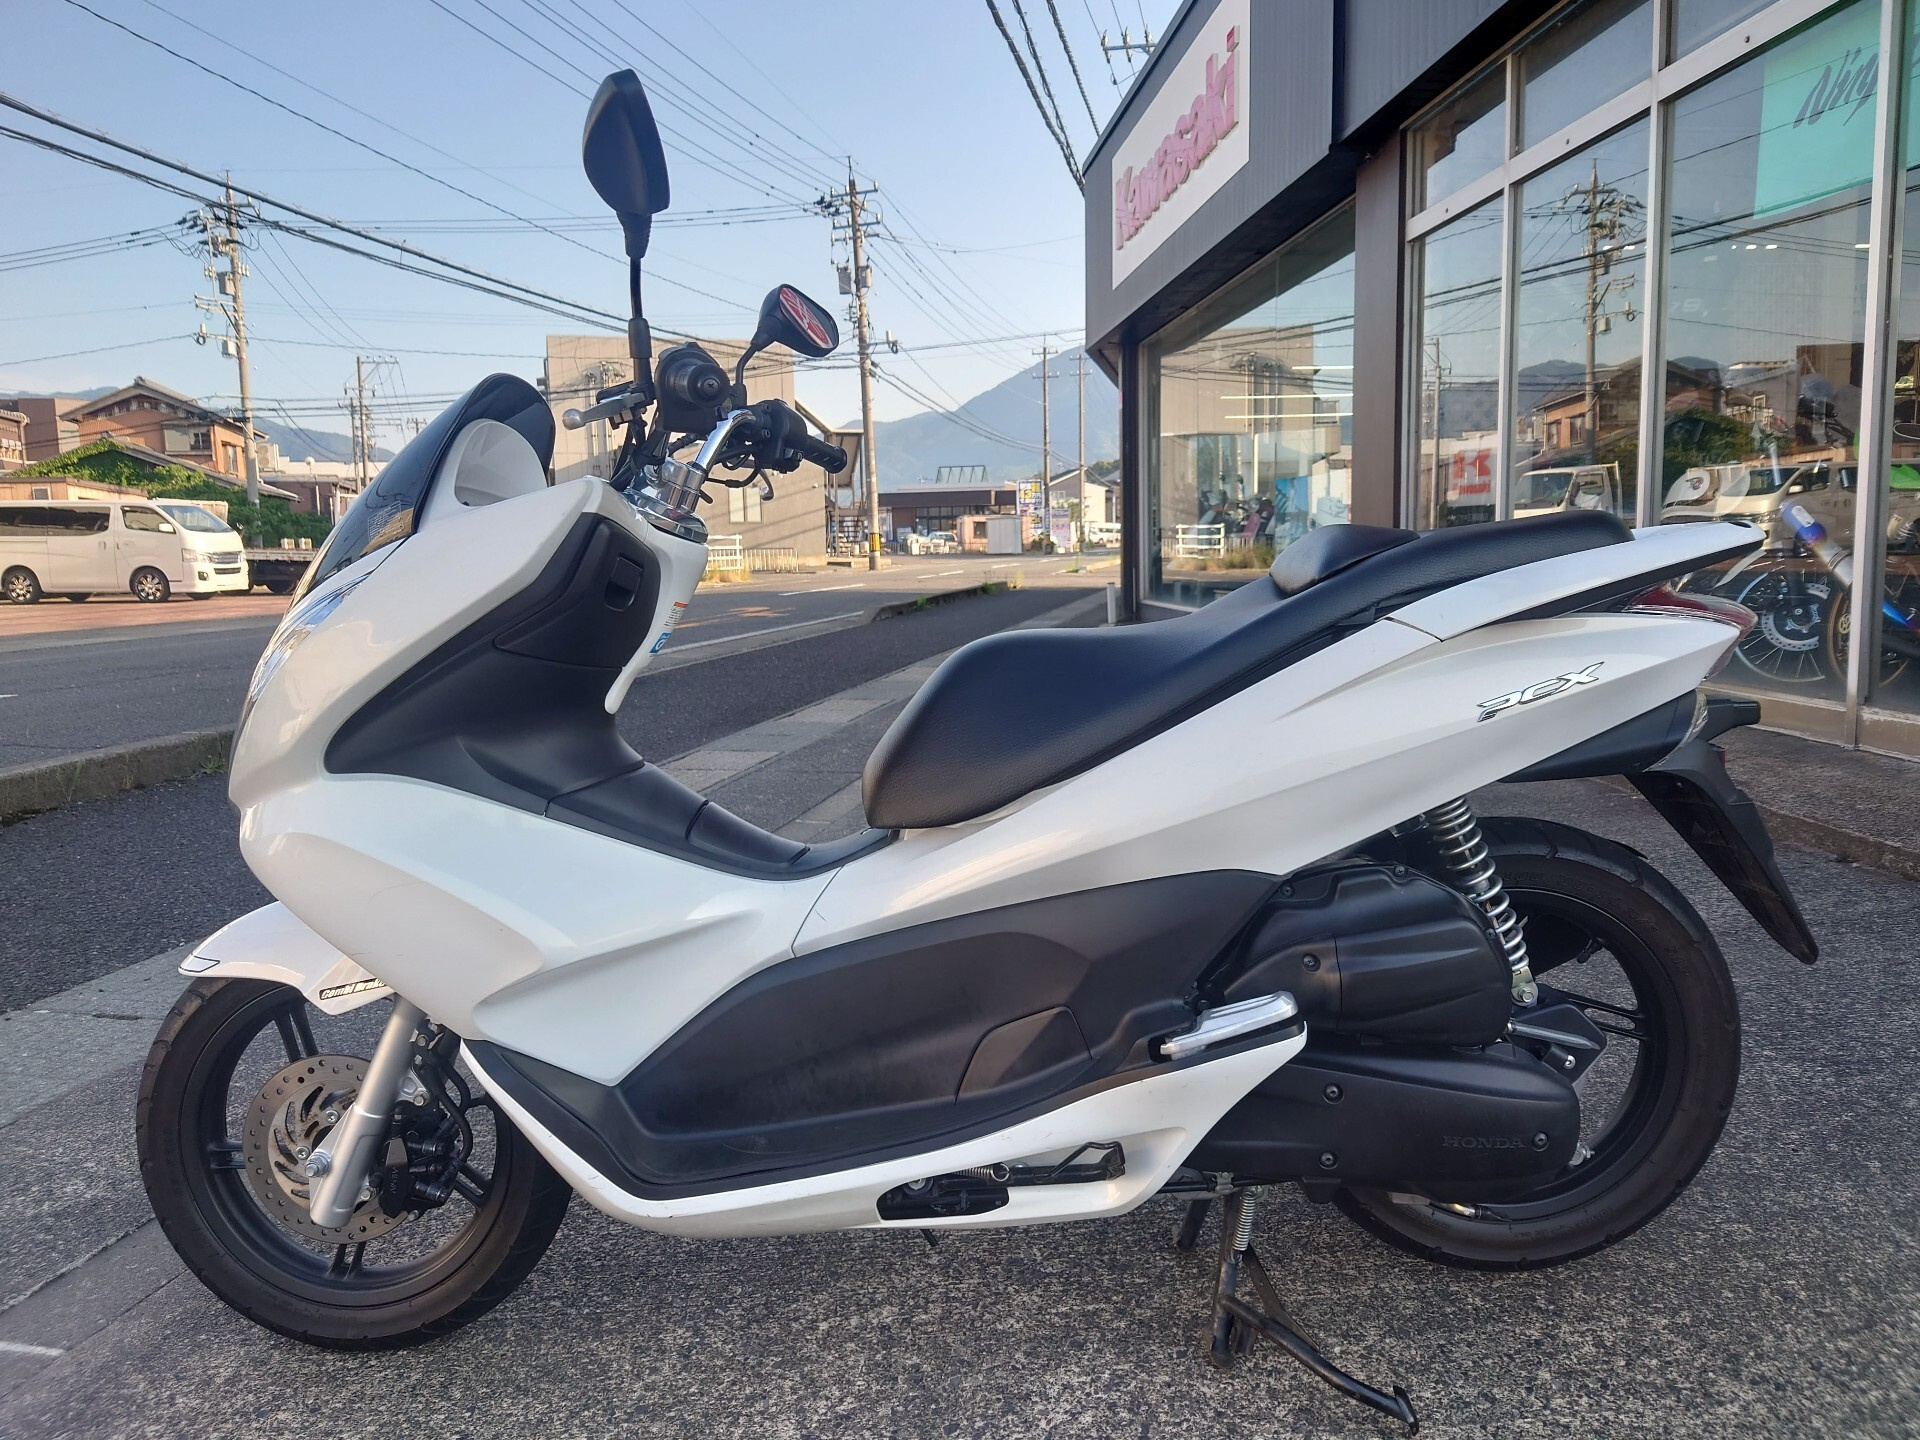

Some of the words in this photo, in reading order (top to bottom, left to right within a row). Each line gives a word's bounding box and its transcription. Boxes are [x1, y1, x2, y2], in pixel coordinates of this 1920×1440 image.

[1116, 25, 1240, 250] Kawasaki
[1477, 661, 1605, 722] PCX
[1442, 1135, 1527, 1149] HONDA
